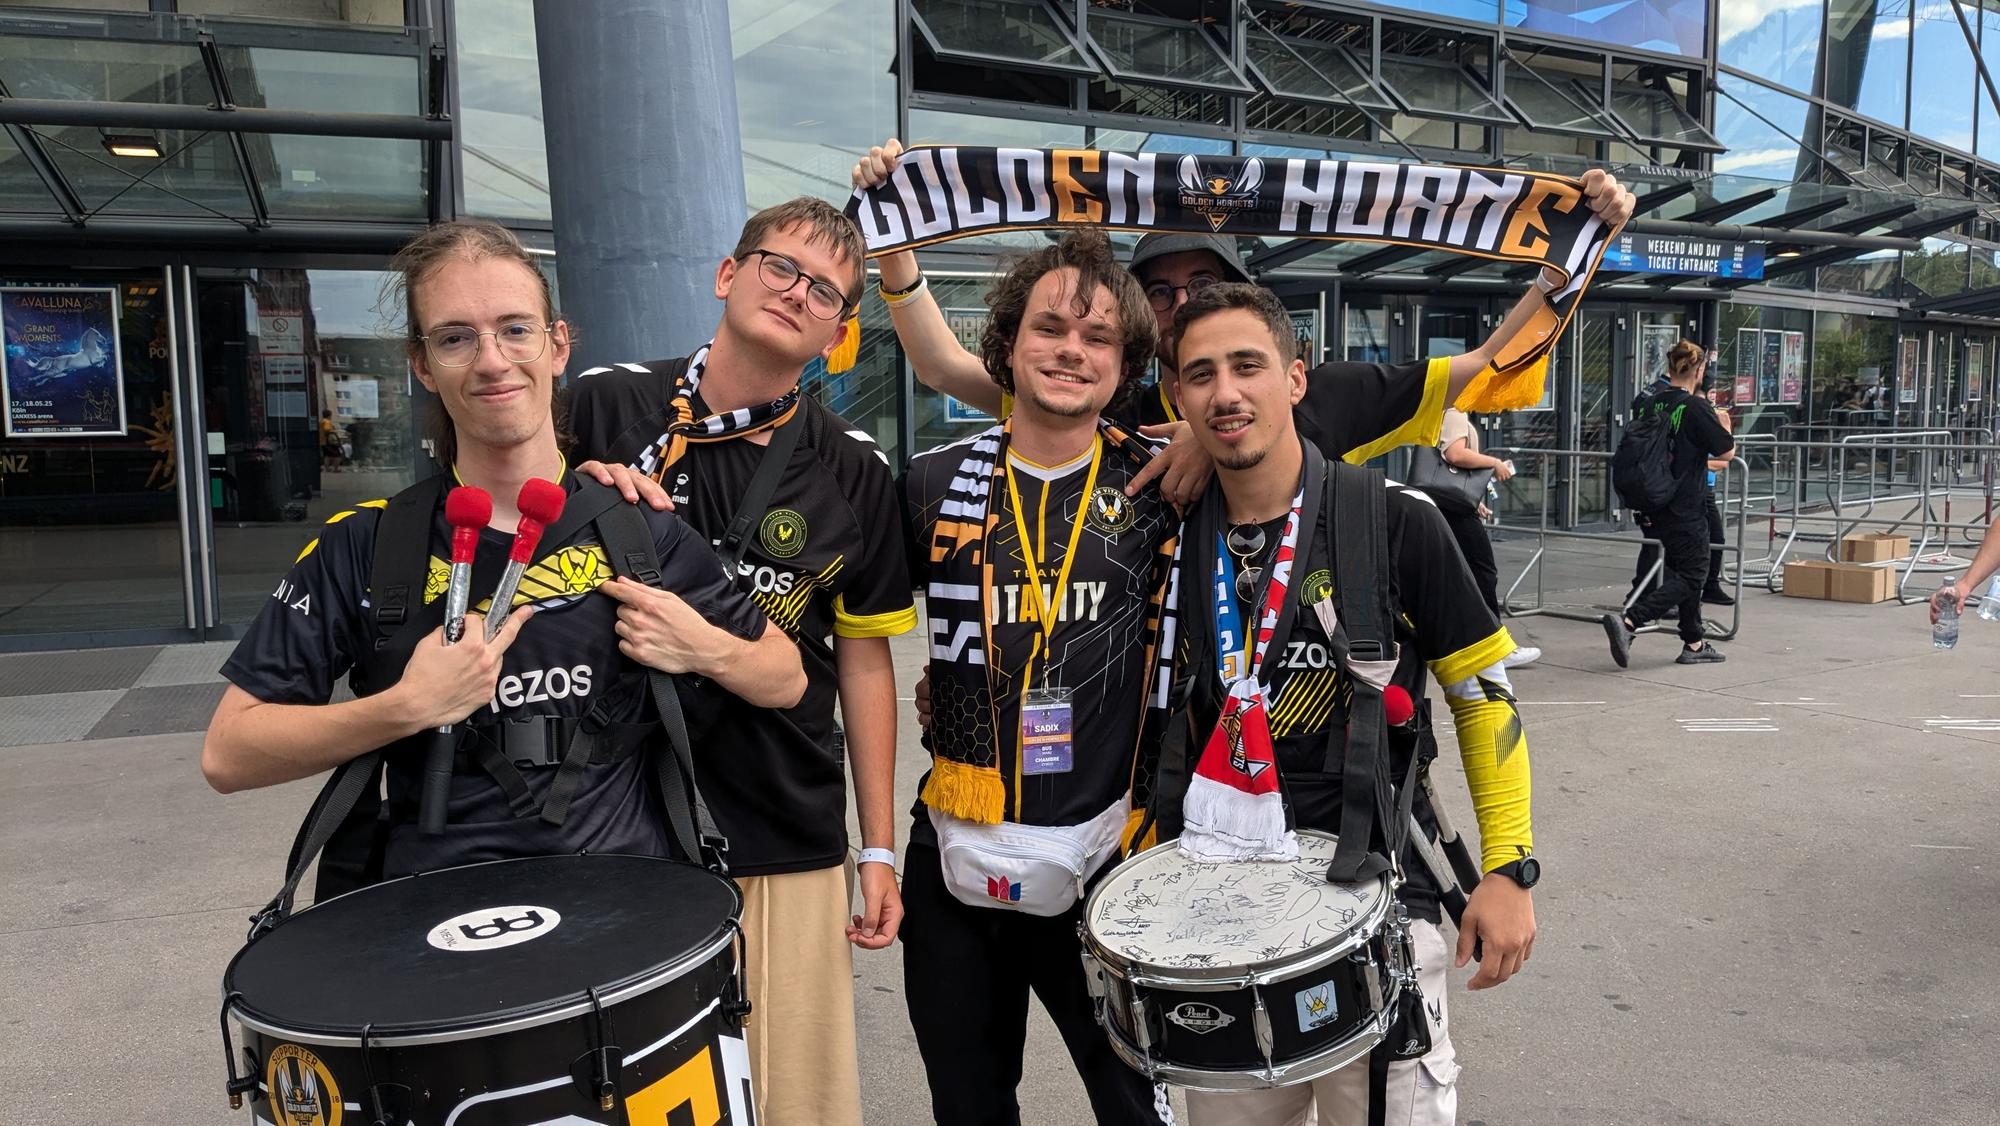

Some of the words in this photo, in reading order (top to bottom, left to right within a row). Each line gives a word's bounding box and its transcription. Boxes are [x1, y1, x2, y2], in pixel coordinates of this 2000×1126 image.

[1182, 196, 1214, 206] GOLDEN
[1216, 198, 1254, 208] HORNETS
[855, 147, 1158, 250] GOLDEN
[1278, 157, 1606, 290] HORNE
[1647, 239, 1686, 255] WEEKEND
[1687, 242, 1704, 256] AND
[1705, 244, 1722, 258] DAY
[1647, 256, 1677, 270] TICKET
[1678, 258, 1720, 273] ENTRANCE
[14, 296, 82, 309] CAVALLUNA
[24, 324, 56, 334] GRAND
[15, 333, 62, 343] MOMENTS
[1013, 568, 1062, 578] TEAM
[1034, 723, 1060, 733] SADIX
[1183, 1005, 1211, 1019] Pearl
[1175, 1018, 1226, 1026] EXPORT
[271, 1045, 319, 1068] SUPPORTER
